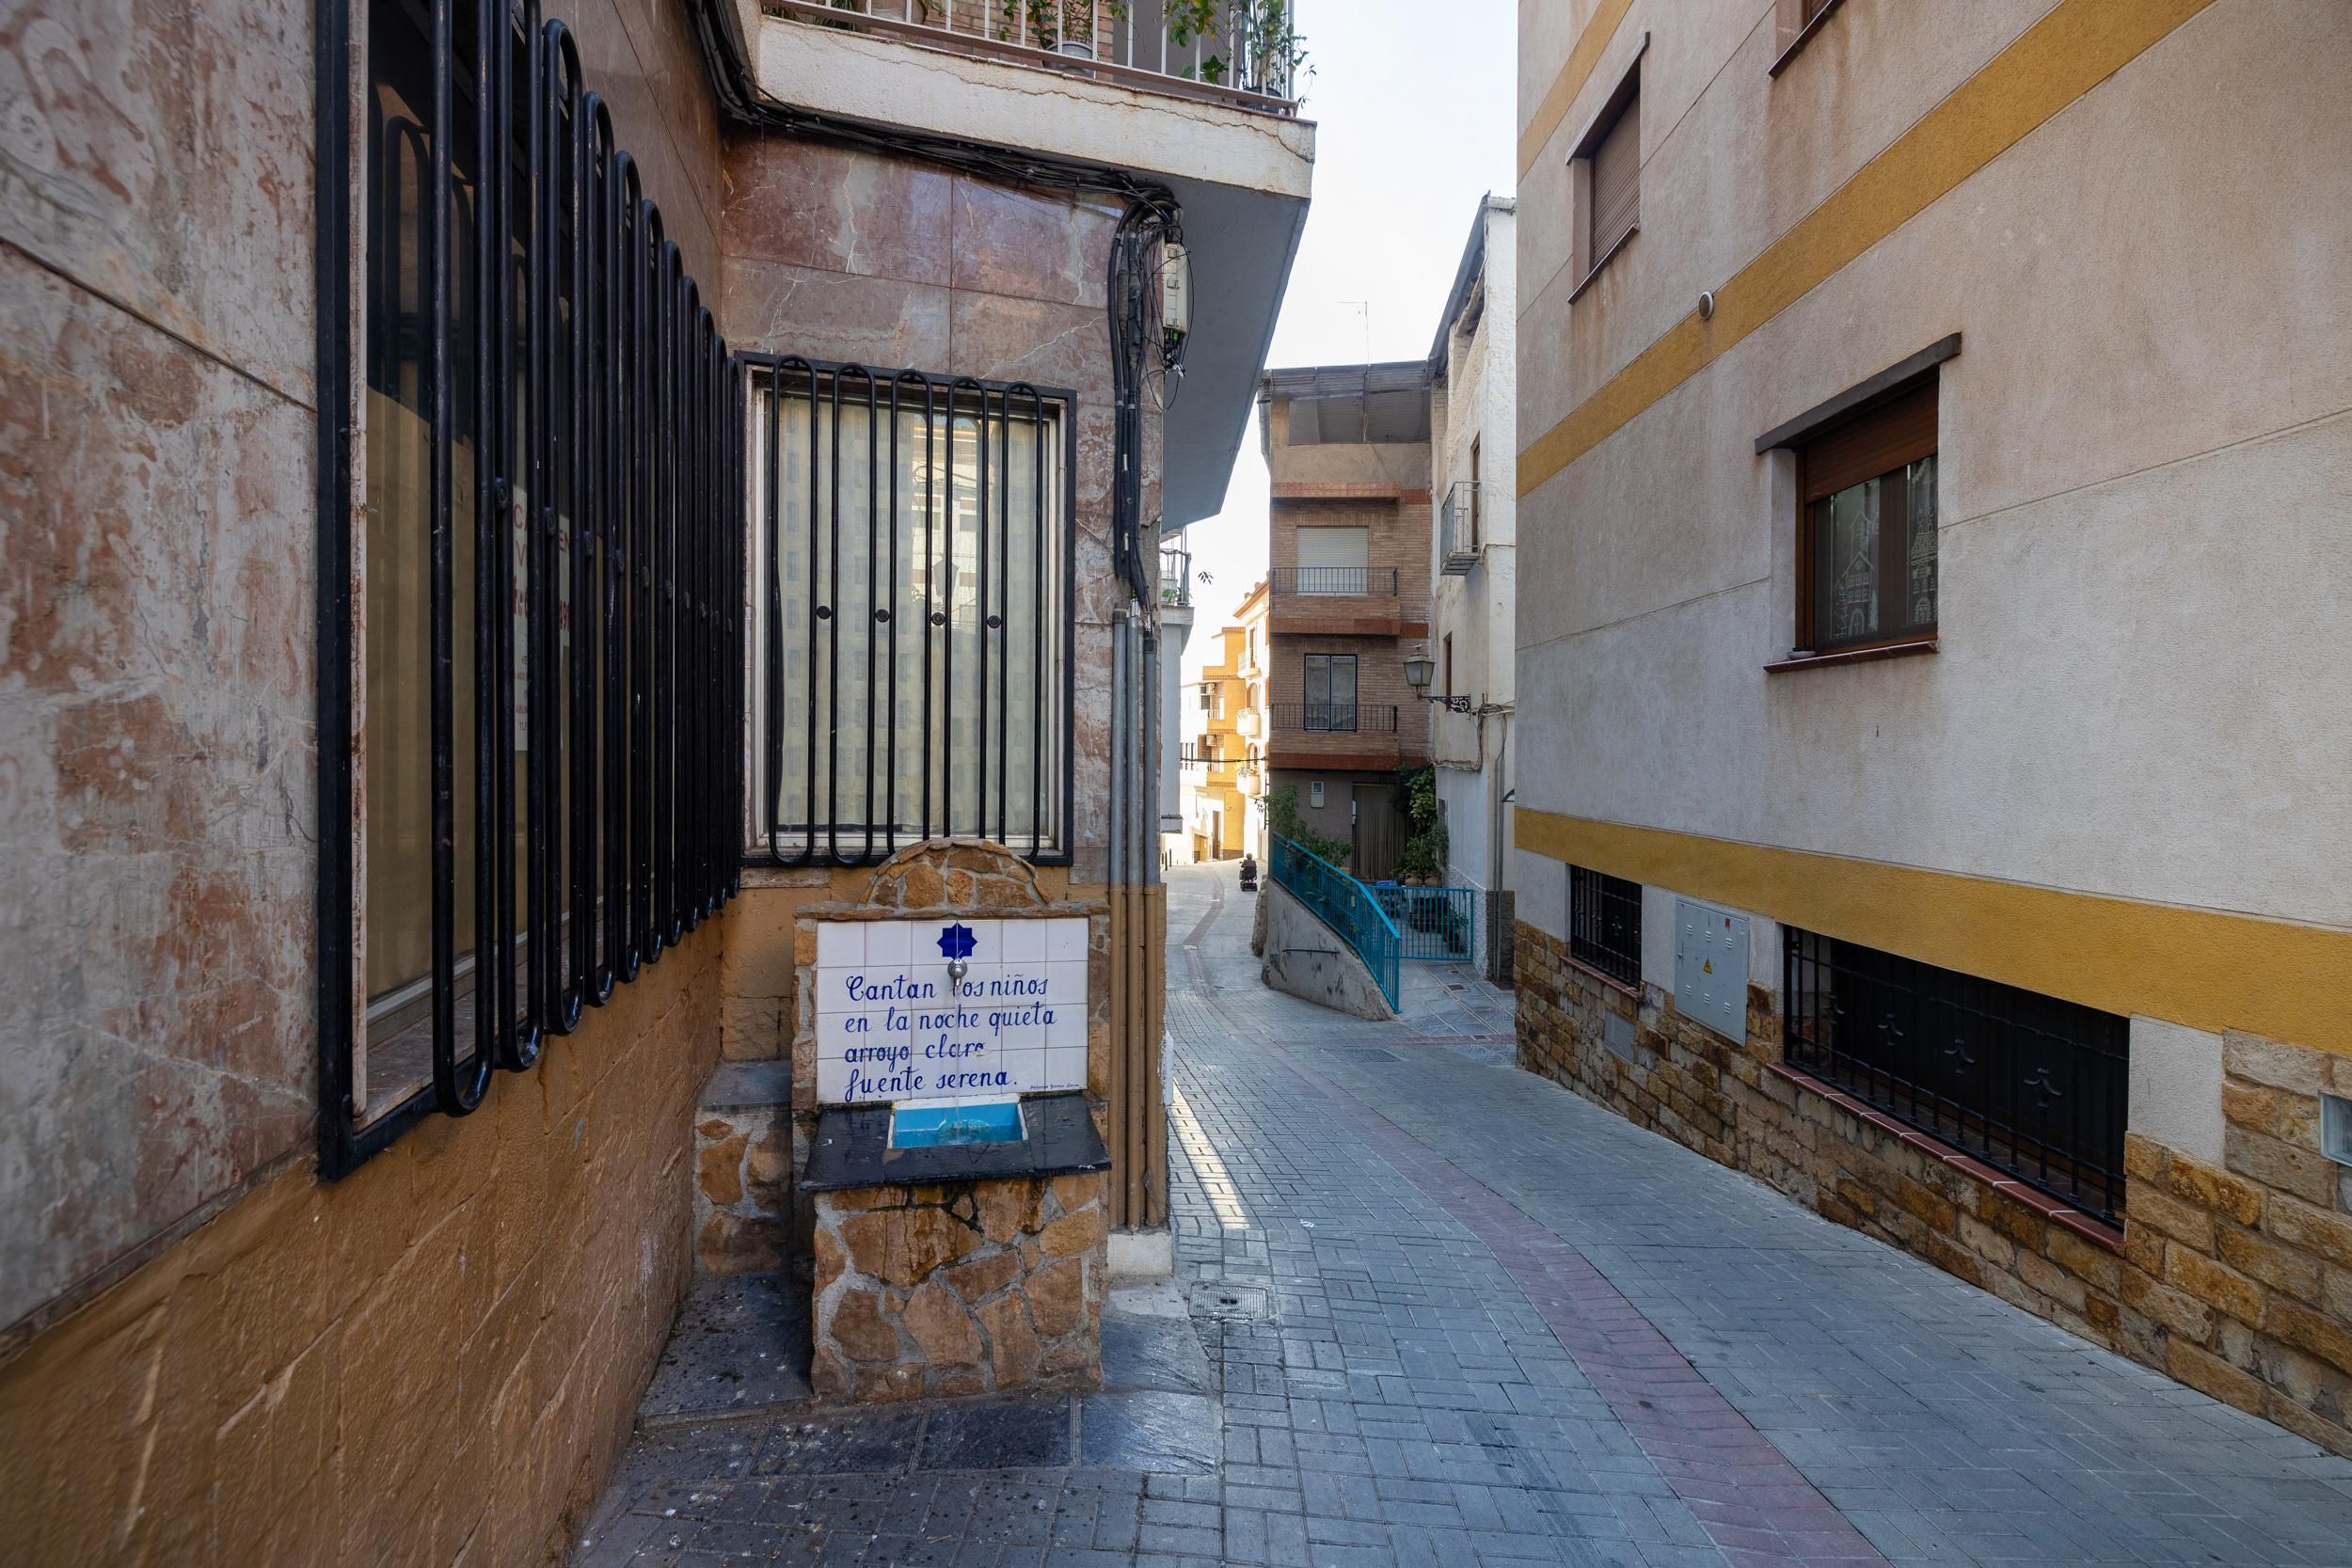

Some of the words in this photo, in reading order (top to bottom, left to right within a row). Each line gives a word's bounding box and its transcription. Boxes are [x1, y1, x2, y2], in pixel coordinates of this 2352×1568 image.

[845, 974, 937, 1002] Cantan
[991, 973, 1049, 997] niños
[845, 1017, 871, 1034] en
[885, 1006, 911, 1032] la
[919, 1004, 980, 1030] noche
[989, 1001, 1057, 1037] quieta
[844, 1045, 912, 1073] arroyo
[844, 1067, 927, 1103] fuente
[935, 1069, 1018, 1088] serena.
